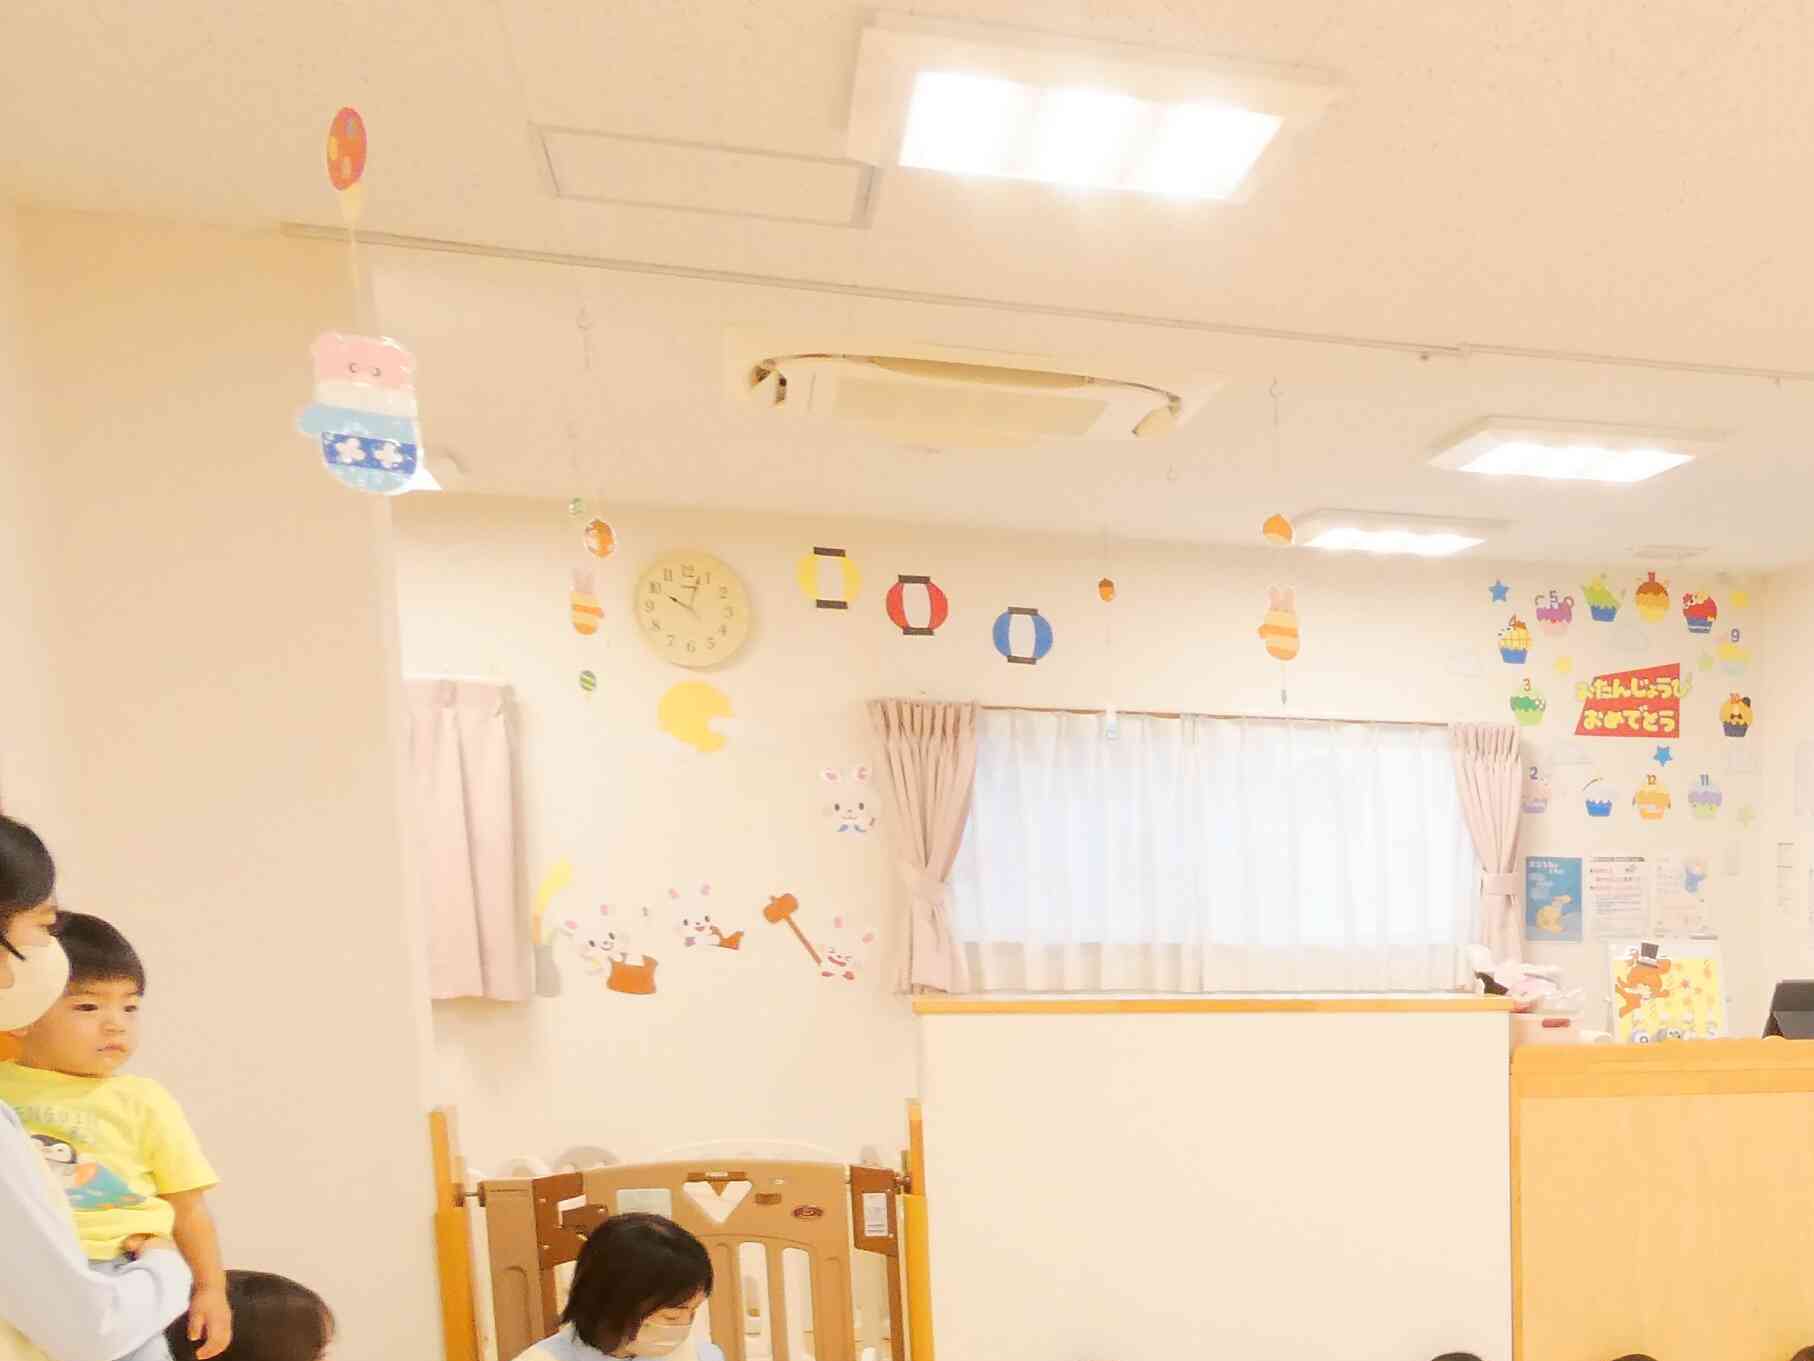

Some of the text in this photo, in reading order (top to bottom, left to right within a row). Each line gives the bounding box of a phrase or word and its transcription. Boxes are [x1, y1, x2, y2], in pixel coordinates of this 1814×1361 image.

[1731, 628, 1740, 642] 9
[1523, 678, 1532, 692] 3
[1583, 705, 1676, 733] おめでとう
[1529, 767, 1538, 780] 2
